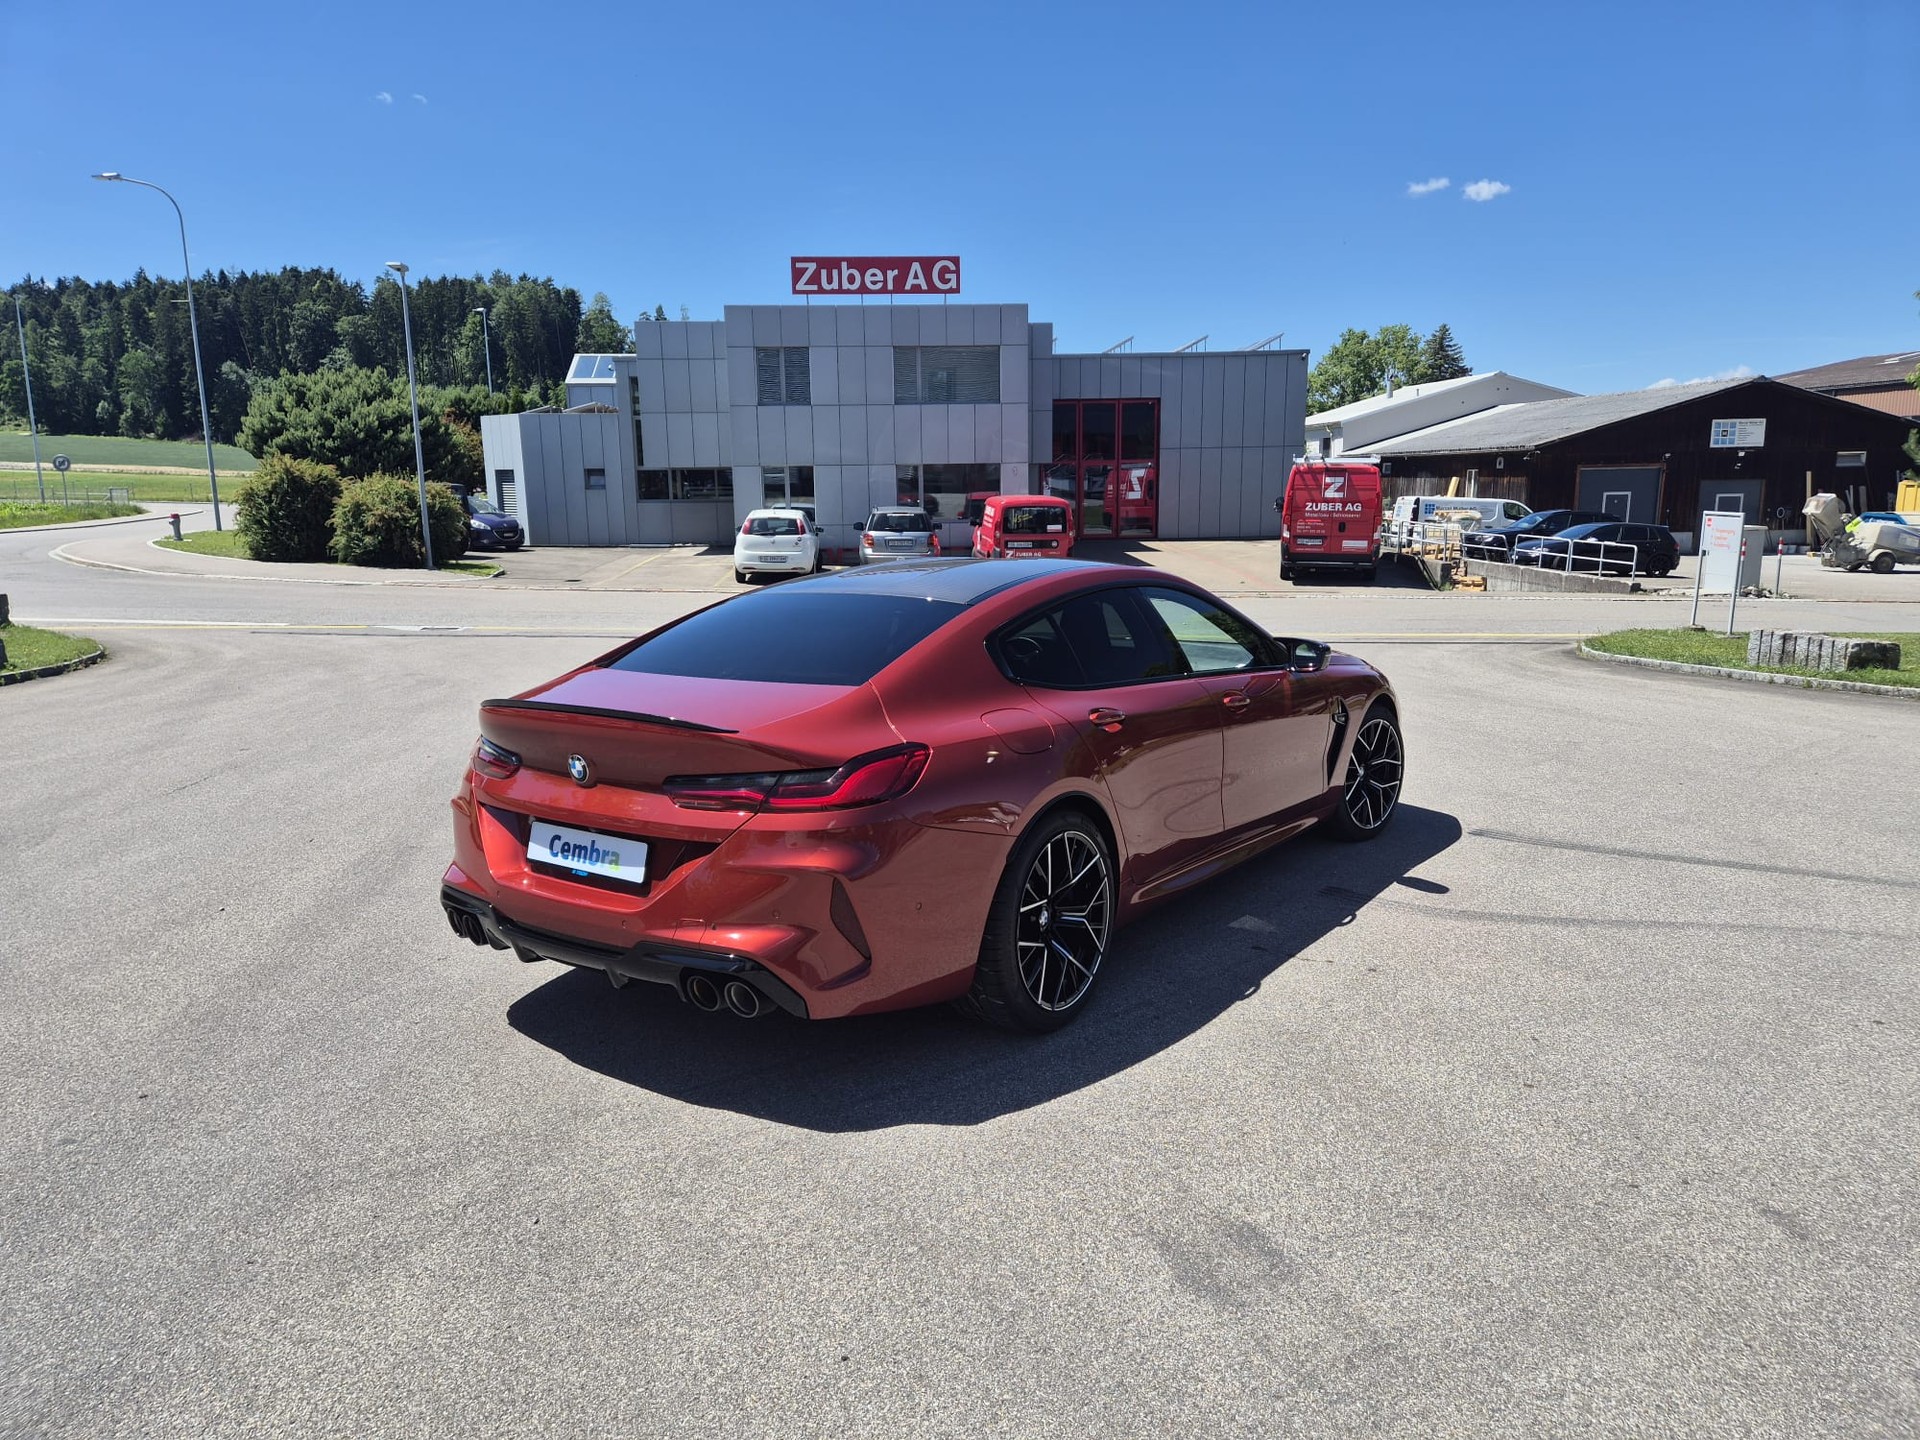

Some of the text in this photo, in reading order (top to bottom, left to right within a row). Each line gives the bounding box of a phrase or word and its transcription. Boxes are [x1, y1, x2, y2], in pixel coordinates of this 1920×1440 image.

[795, 260, 957, 290] Zuber AG
[1324, 476, 1344, 498] Z
[1305, 502, 1362, 511] ZUBER AG
[549, 834, 621, 873] Cembra
